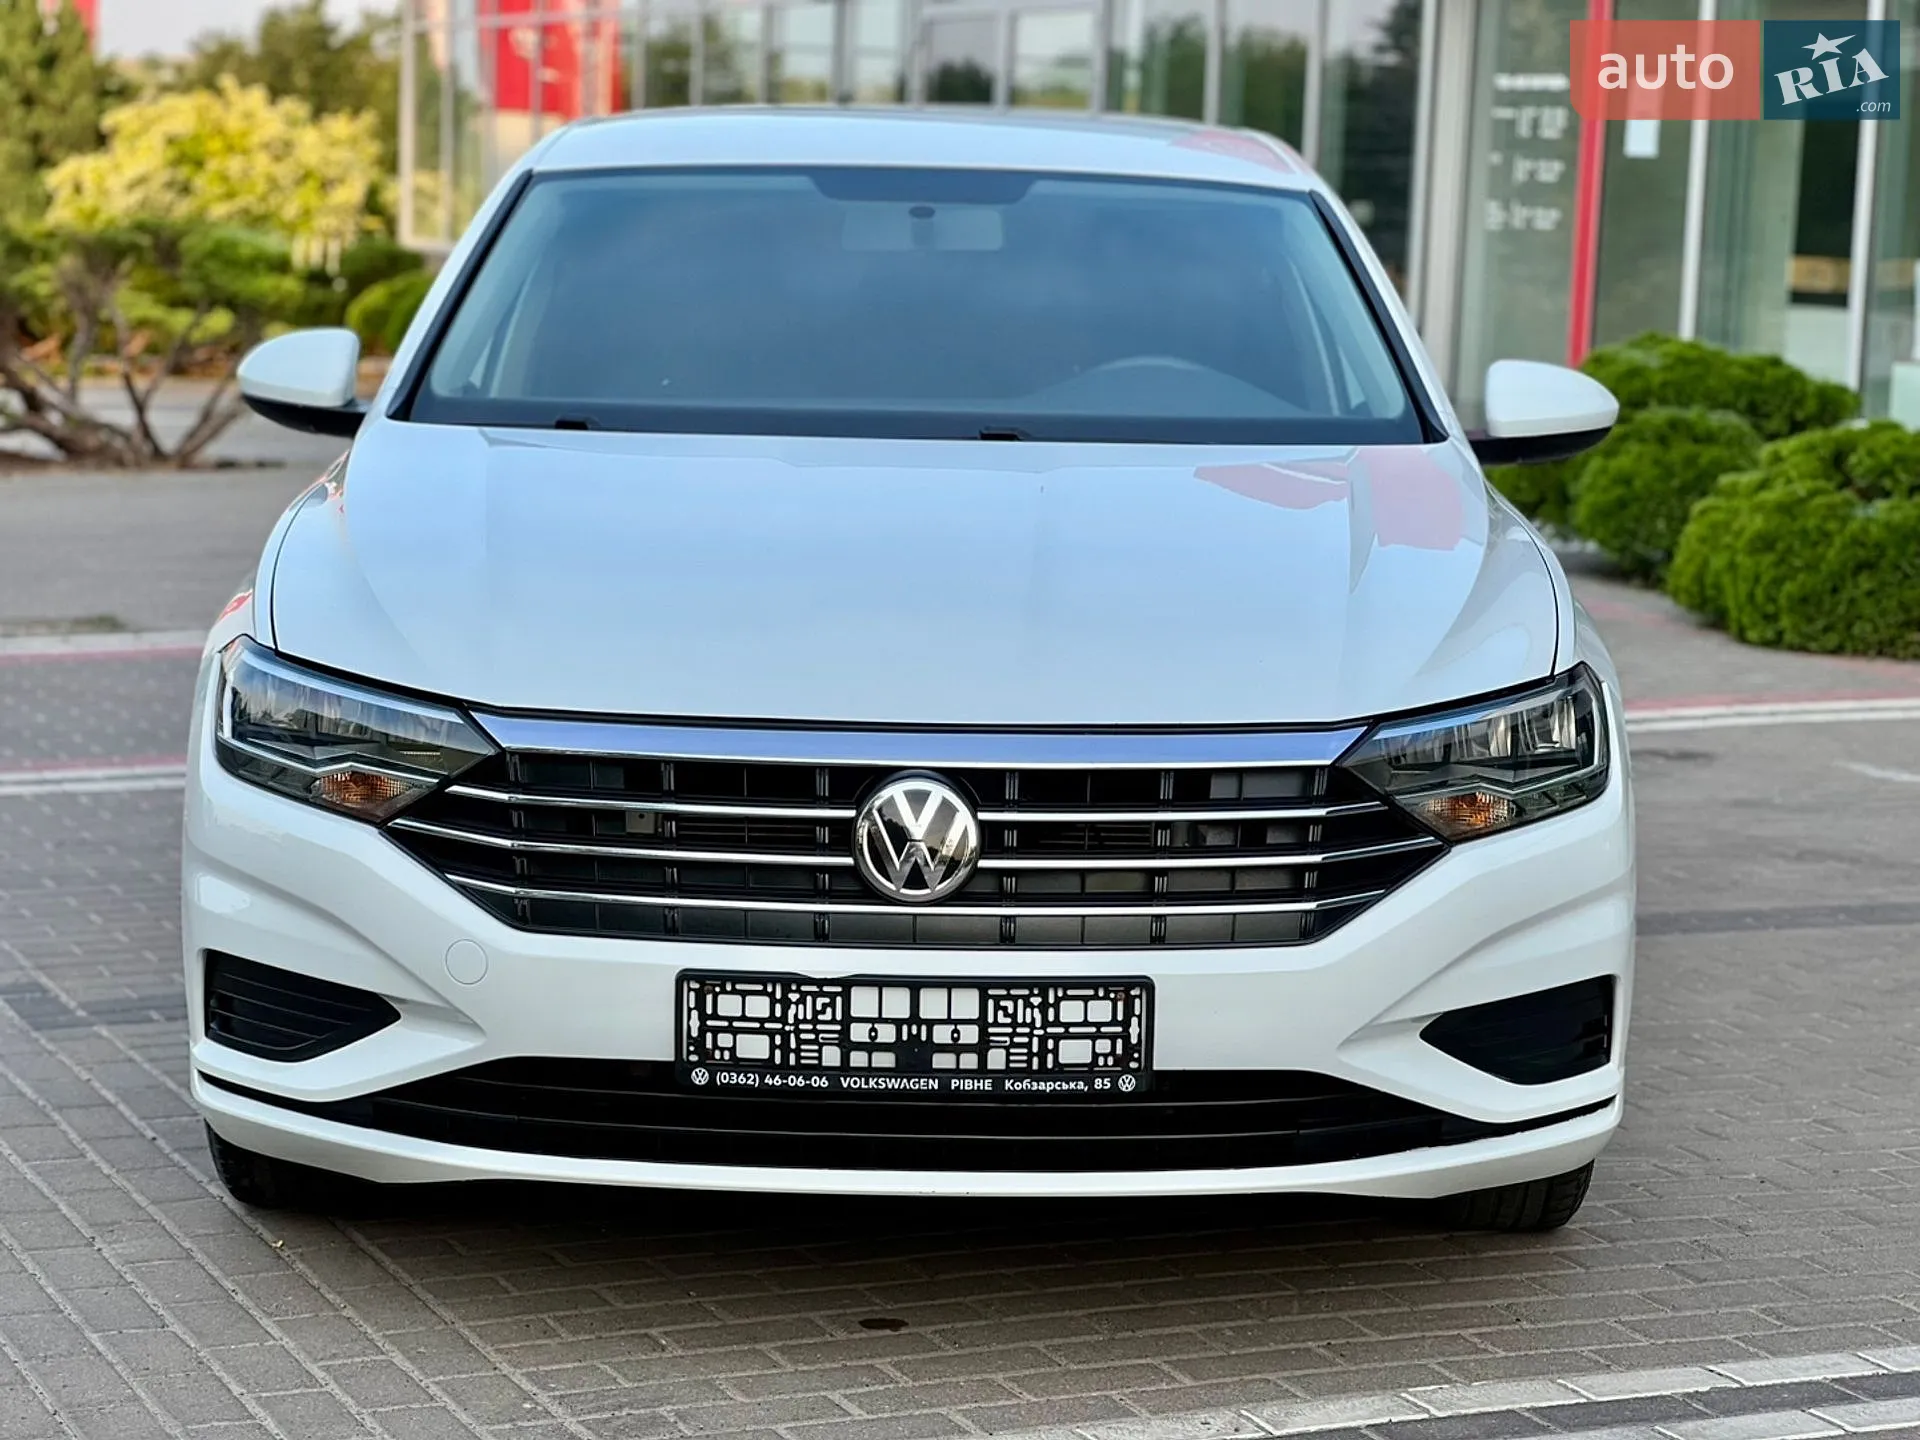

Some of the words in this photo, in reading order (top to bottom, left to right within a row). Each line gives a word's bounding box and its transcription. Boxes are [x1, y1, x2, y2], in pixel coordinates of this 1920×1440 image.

[715, 1071, 760, 1088] (0362)
[764, 1074, 829, 1088] 46-06-06
[840, 1076, 939, 1090] VOLKSWAGEN
[950, 1078, 993, 1091] РІВНЕ
[1004, 1078, 1089, 1093] Кобзарська,
[1093, 1077, 1111, 1090] 85
